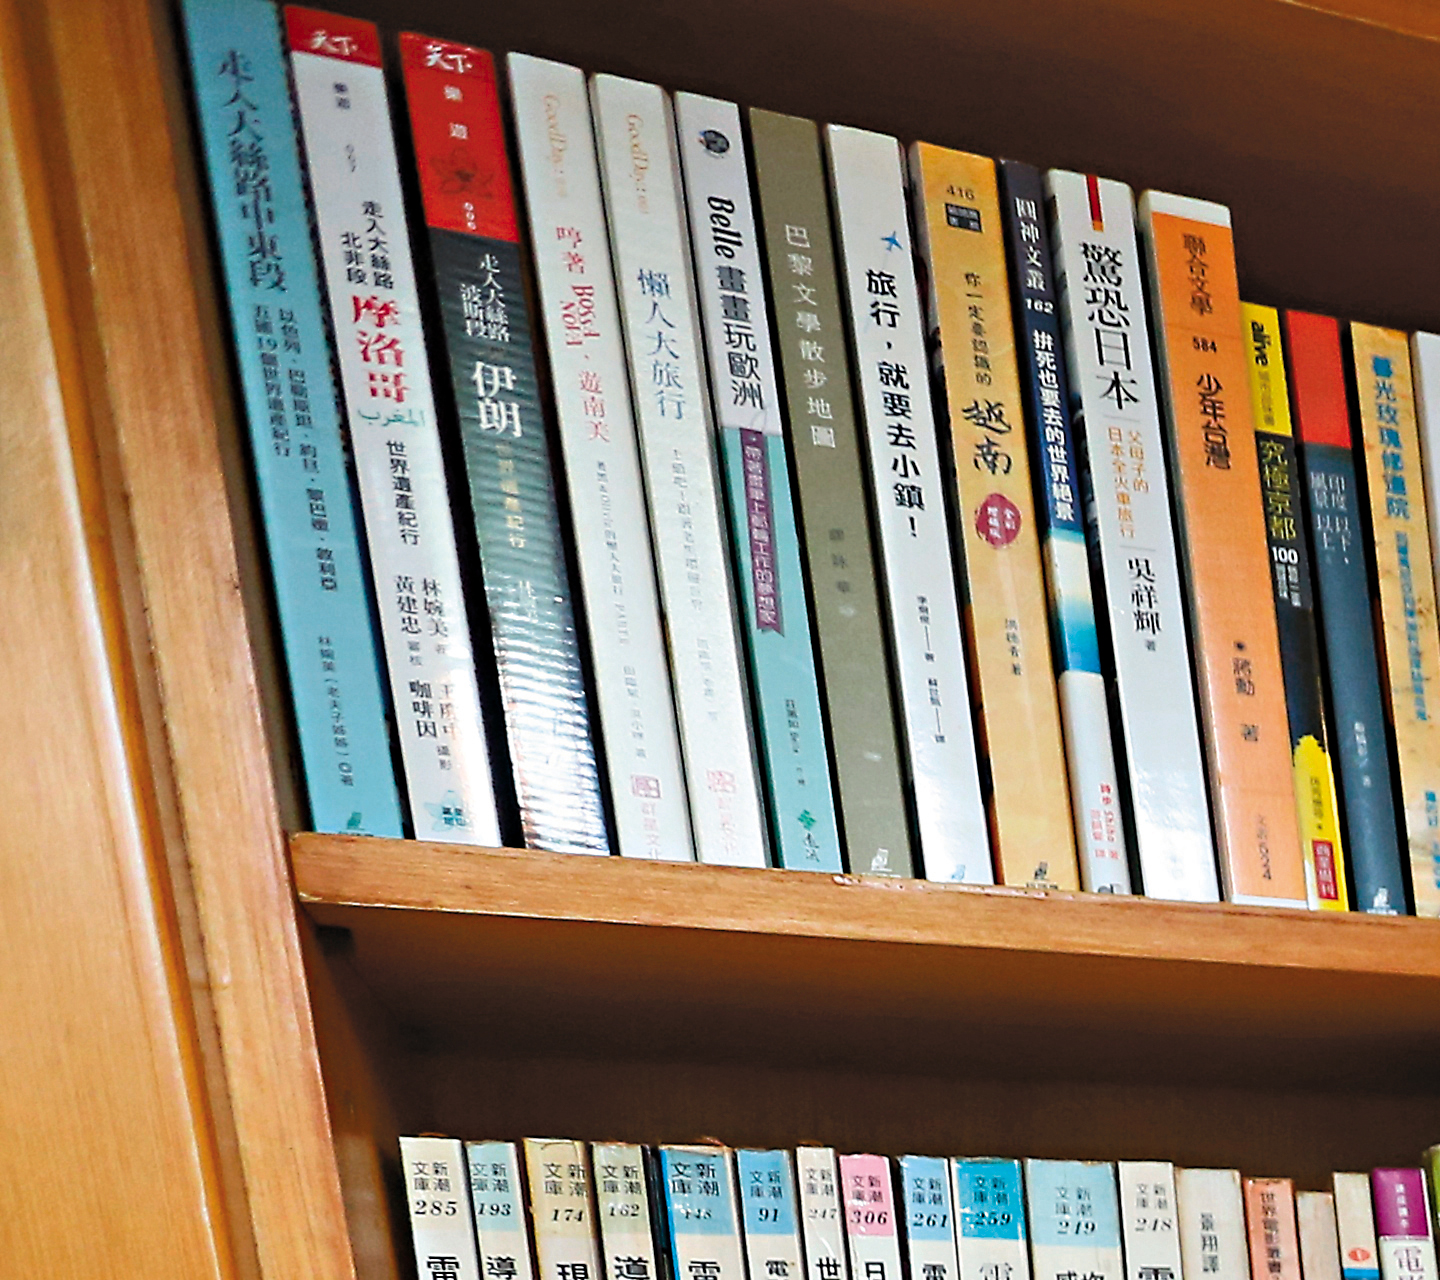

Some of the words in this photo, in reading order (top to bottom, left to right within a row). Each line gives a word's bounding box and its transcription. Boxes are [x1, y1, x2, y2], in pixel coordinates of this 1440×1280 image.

[707, 194, 743, 260] Belle
[340, 232, 369, 287] 北非段
[351, 295, 409, 404] 摩洛哥
[636, 267, 687, 421] 懶人大旅行
[715, 263, 765, 411] 畫畫玩歐洲
[784, 224, 837, 448] 巴黎文學散步地圖
[1079, 241, 1141, 411] 驚恐日本
[1193, 336, 1217, 353] 584
[1251, 321, 1269, 368] alive
[472, 359, 525, 437] 伊朗
[961, 399, 1013, 477] 越南
[386, 439, 420, 547] 世界遺產紀行
[1271, 546, 1300, 566] 100
[1126, 556, 1162, 636] 吳祥輝
[413, 1200, 458, 1217] 285
[477, 1202, 512, 1217] 193
[757, 1208, 781, 1223] 91
[850, 1210, 889, 1226] 306
[912, 1213, 948, 1228] 261
[974, 1212, 1012, 1227] 259
